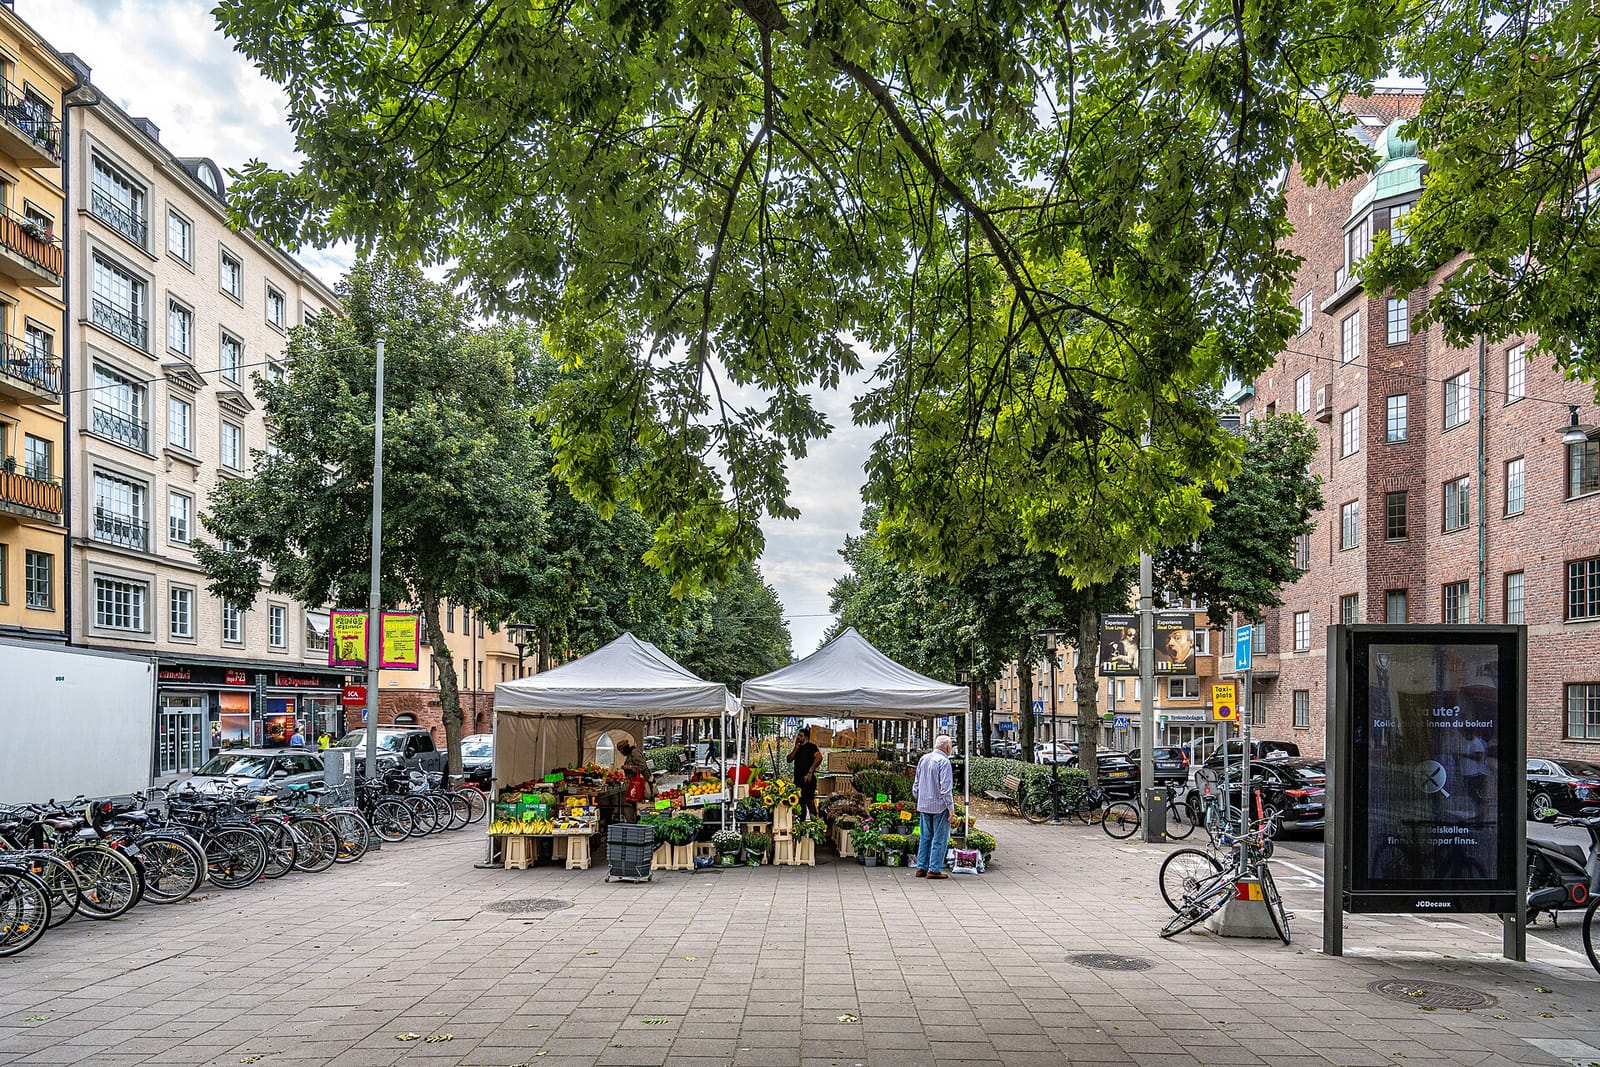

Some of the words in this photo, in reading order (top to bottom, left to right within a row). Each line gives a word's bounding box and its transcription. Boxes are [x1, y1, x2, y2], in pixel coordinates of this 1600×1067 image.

[1432, 705, 1460, 717] ute?
[1374, 720, 1396, 728] Kolla
[1426, 720, 1451, 728] innan
[1452, 720, 1464, 728] du
[1465, 720, 1493, 728] bokar!
[1426, 838, 1452, 846] appar
[1454, 836, 1478, 845] finns.
